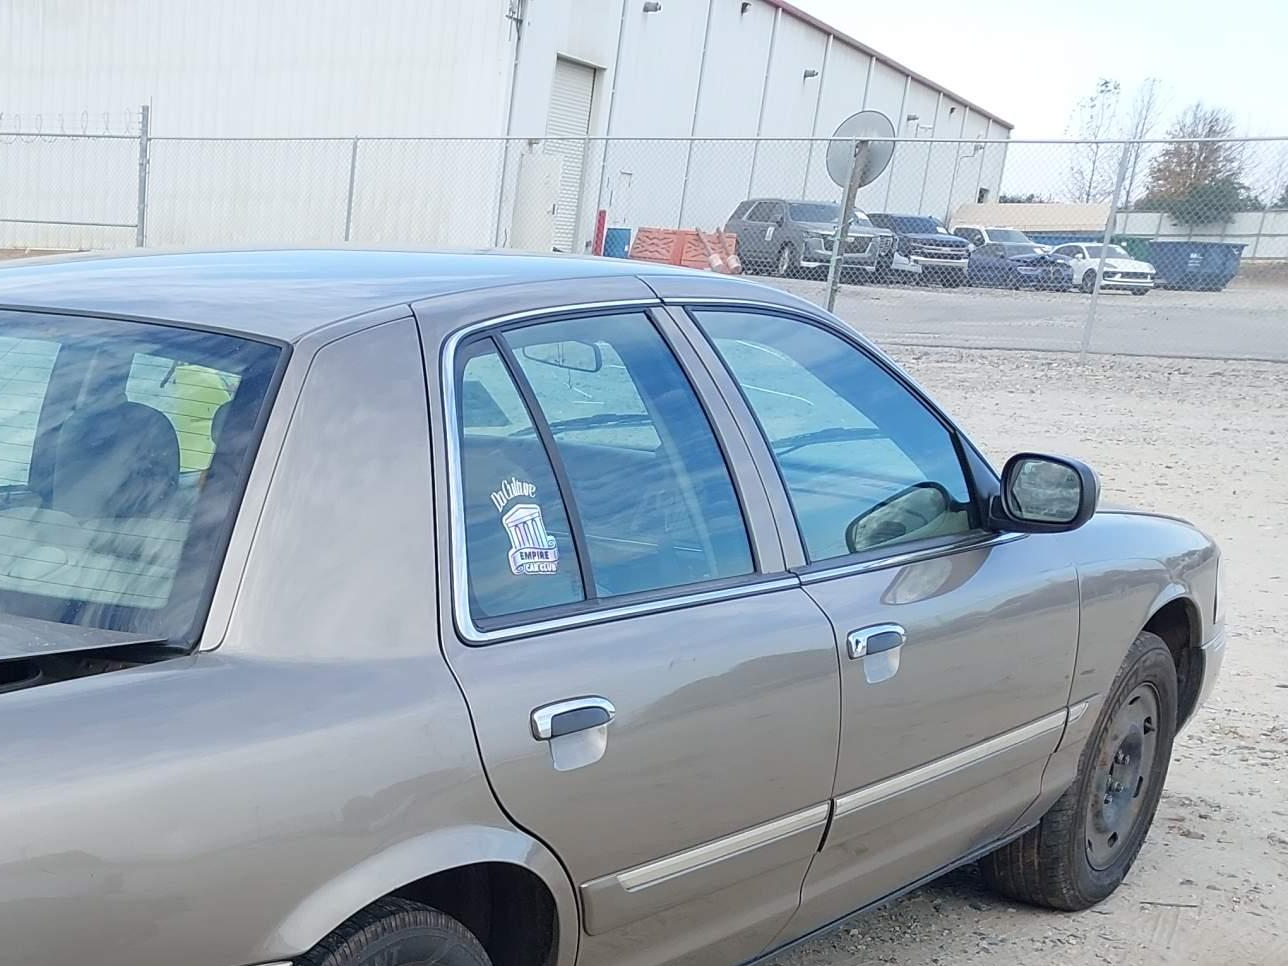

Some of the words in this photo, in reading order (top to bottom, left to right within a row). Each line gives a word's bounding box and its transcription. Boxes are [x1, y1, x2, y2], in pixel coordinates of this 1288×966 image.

[520, 551, 550, 561] EMPIRE
[525, 563, 539, 572] CAR
[539, 563, 557, 572] CLUB
